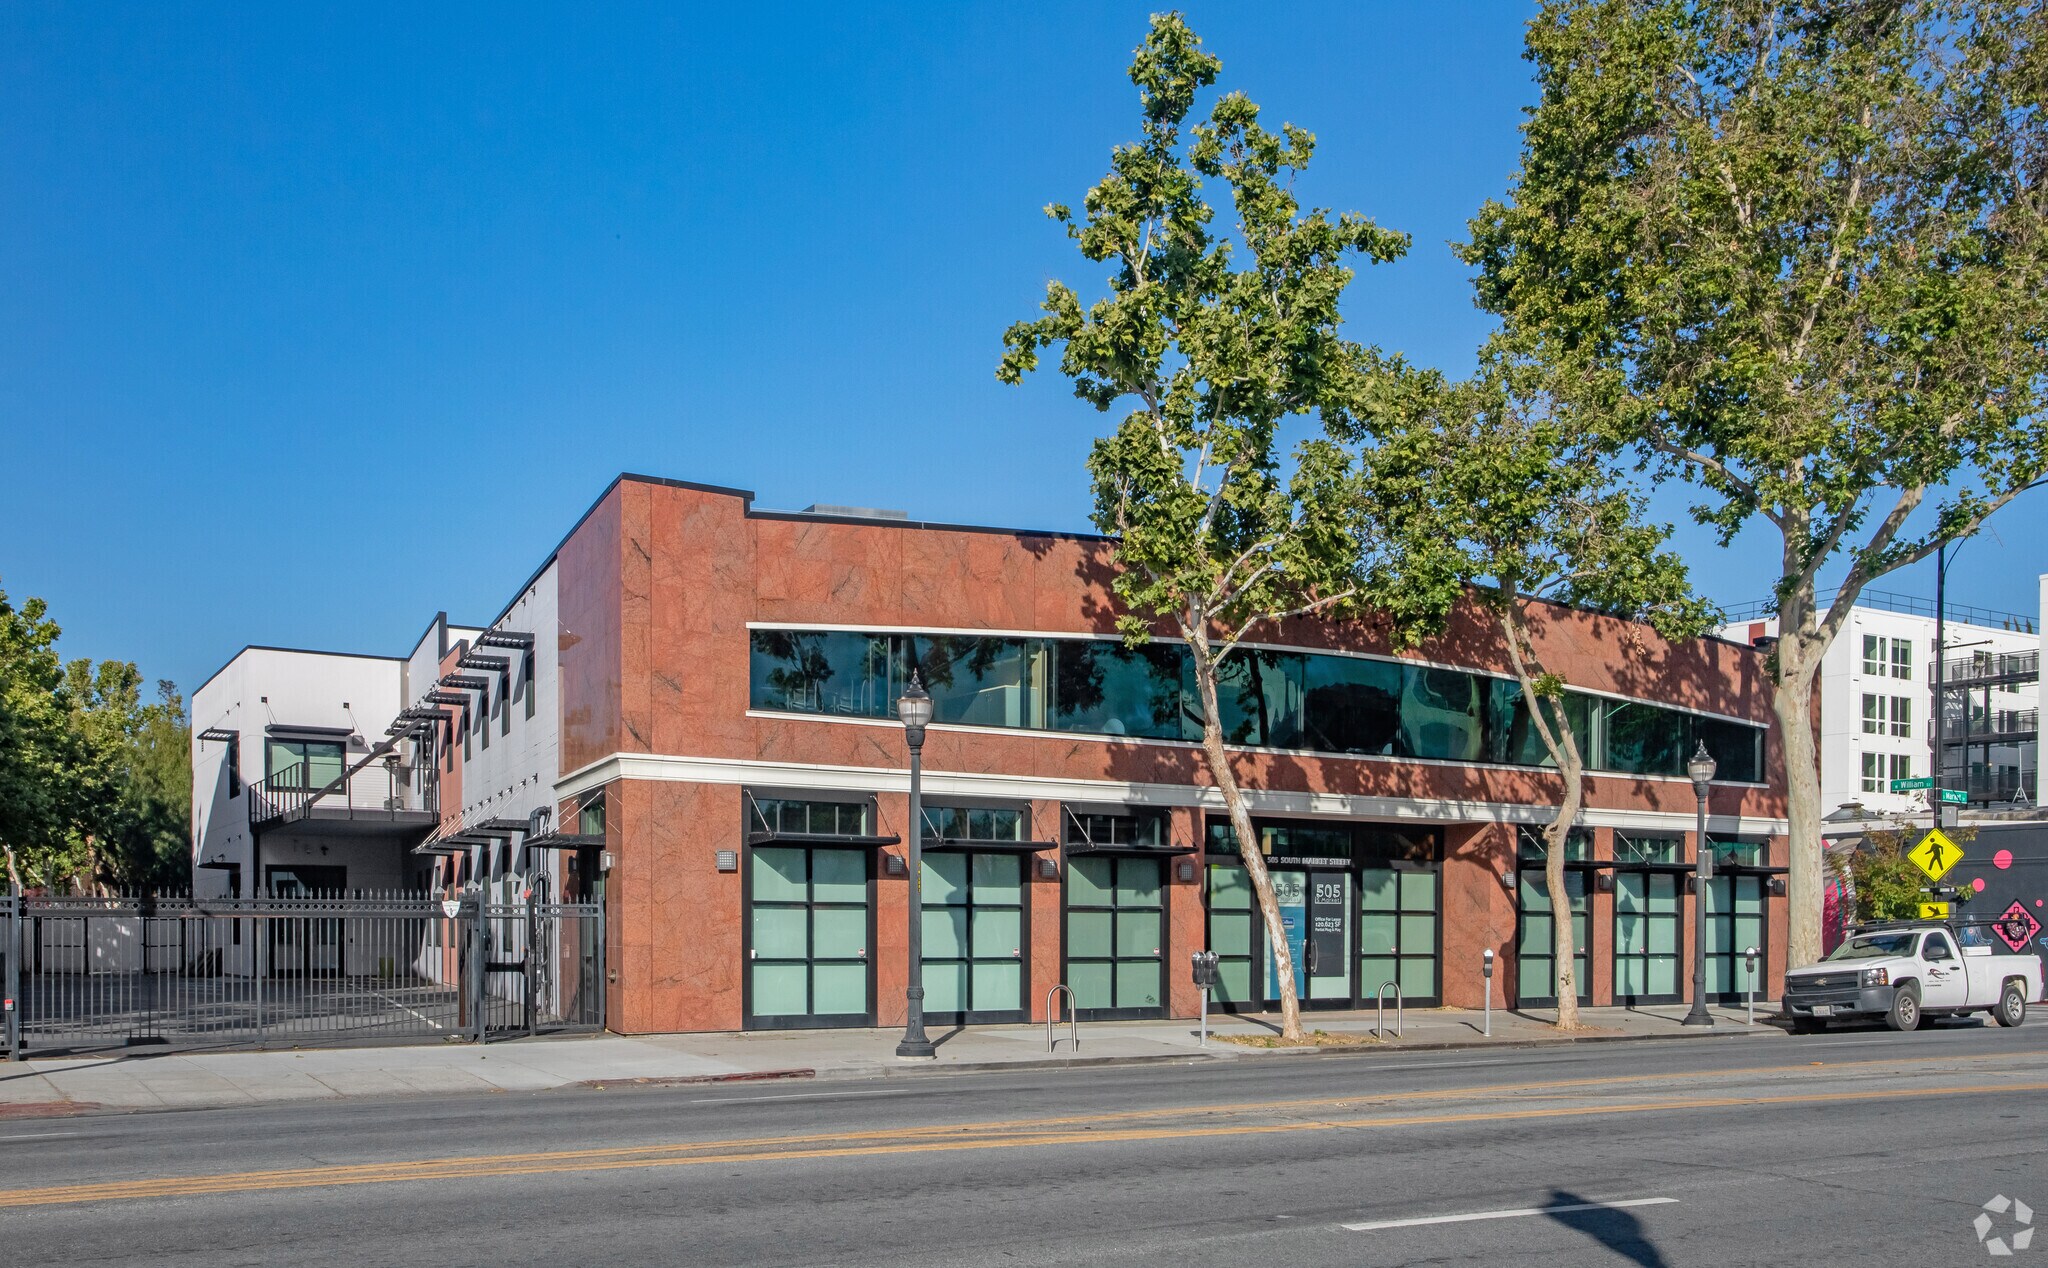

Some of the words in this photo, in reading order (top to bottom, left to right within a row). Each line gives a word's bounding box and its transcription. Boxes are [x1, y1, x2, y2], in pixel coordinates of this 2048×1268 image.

[1900, 781, 1924, 789] William
[1945, 792, 1962, 801] Market
[1267, 856, 1279, 864] 505
[1280, 856, 1301, 864] SOUTH
[1301, 857, 1328, 865] MARKET
[1329, 858, 1352, 866] STREET
[1275, 883, 1300, 898] 505
[1315, 883, 1341, 898] 505
